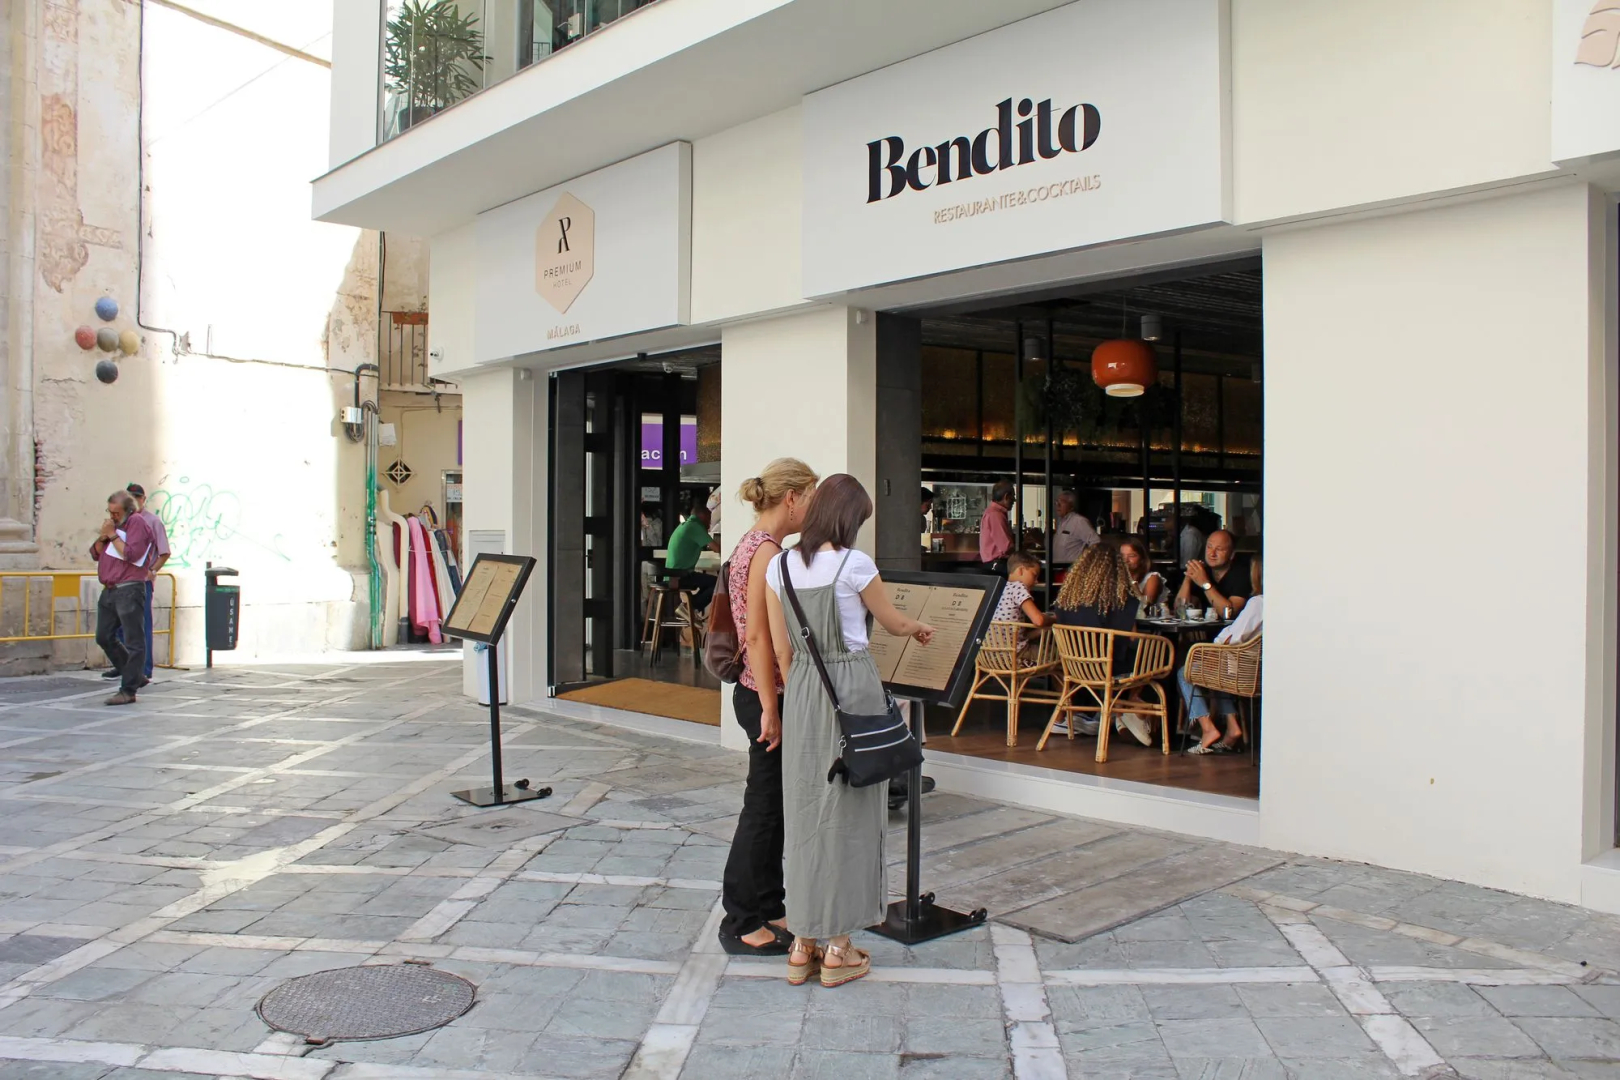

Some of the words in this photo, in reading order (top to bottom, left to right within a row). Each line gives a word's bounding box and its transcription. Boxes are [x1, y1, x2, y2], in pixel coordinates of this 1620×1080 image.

[866, 97, 1101, 204] Bendito
[543, 260, 582, 280] PREMIUM
[552, 279, 572, 288] HOTEL
[546, 323, 581, 341] MÁLAGA
